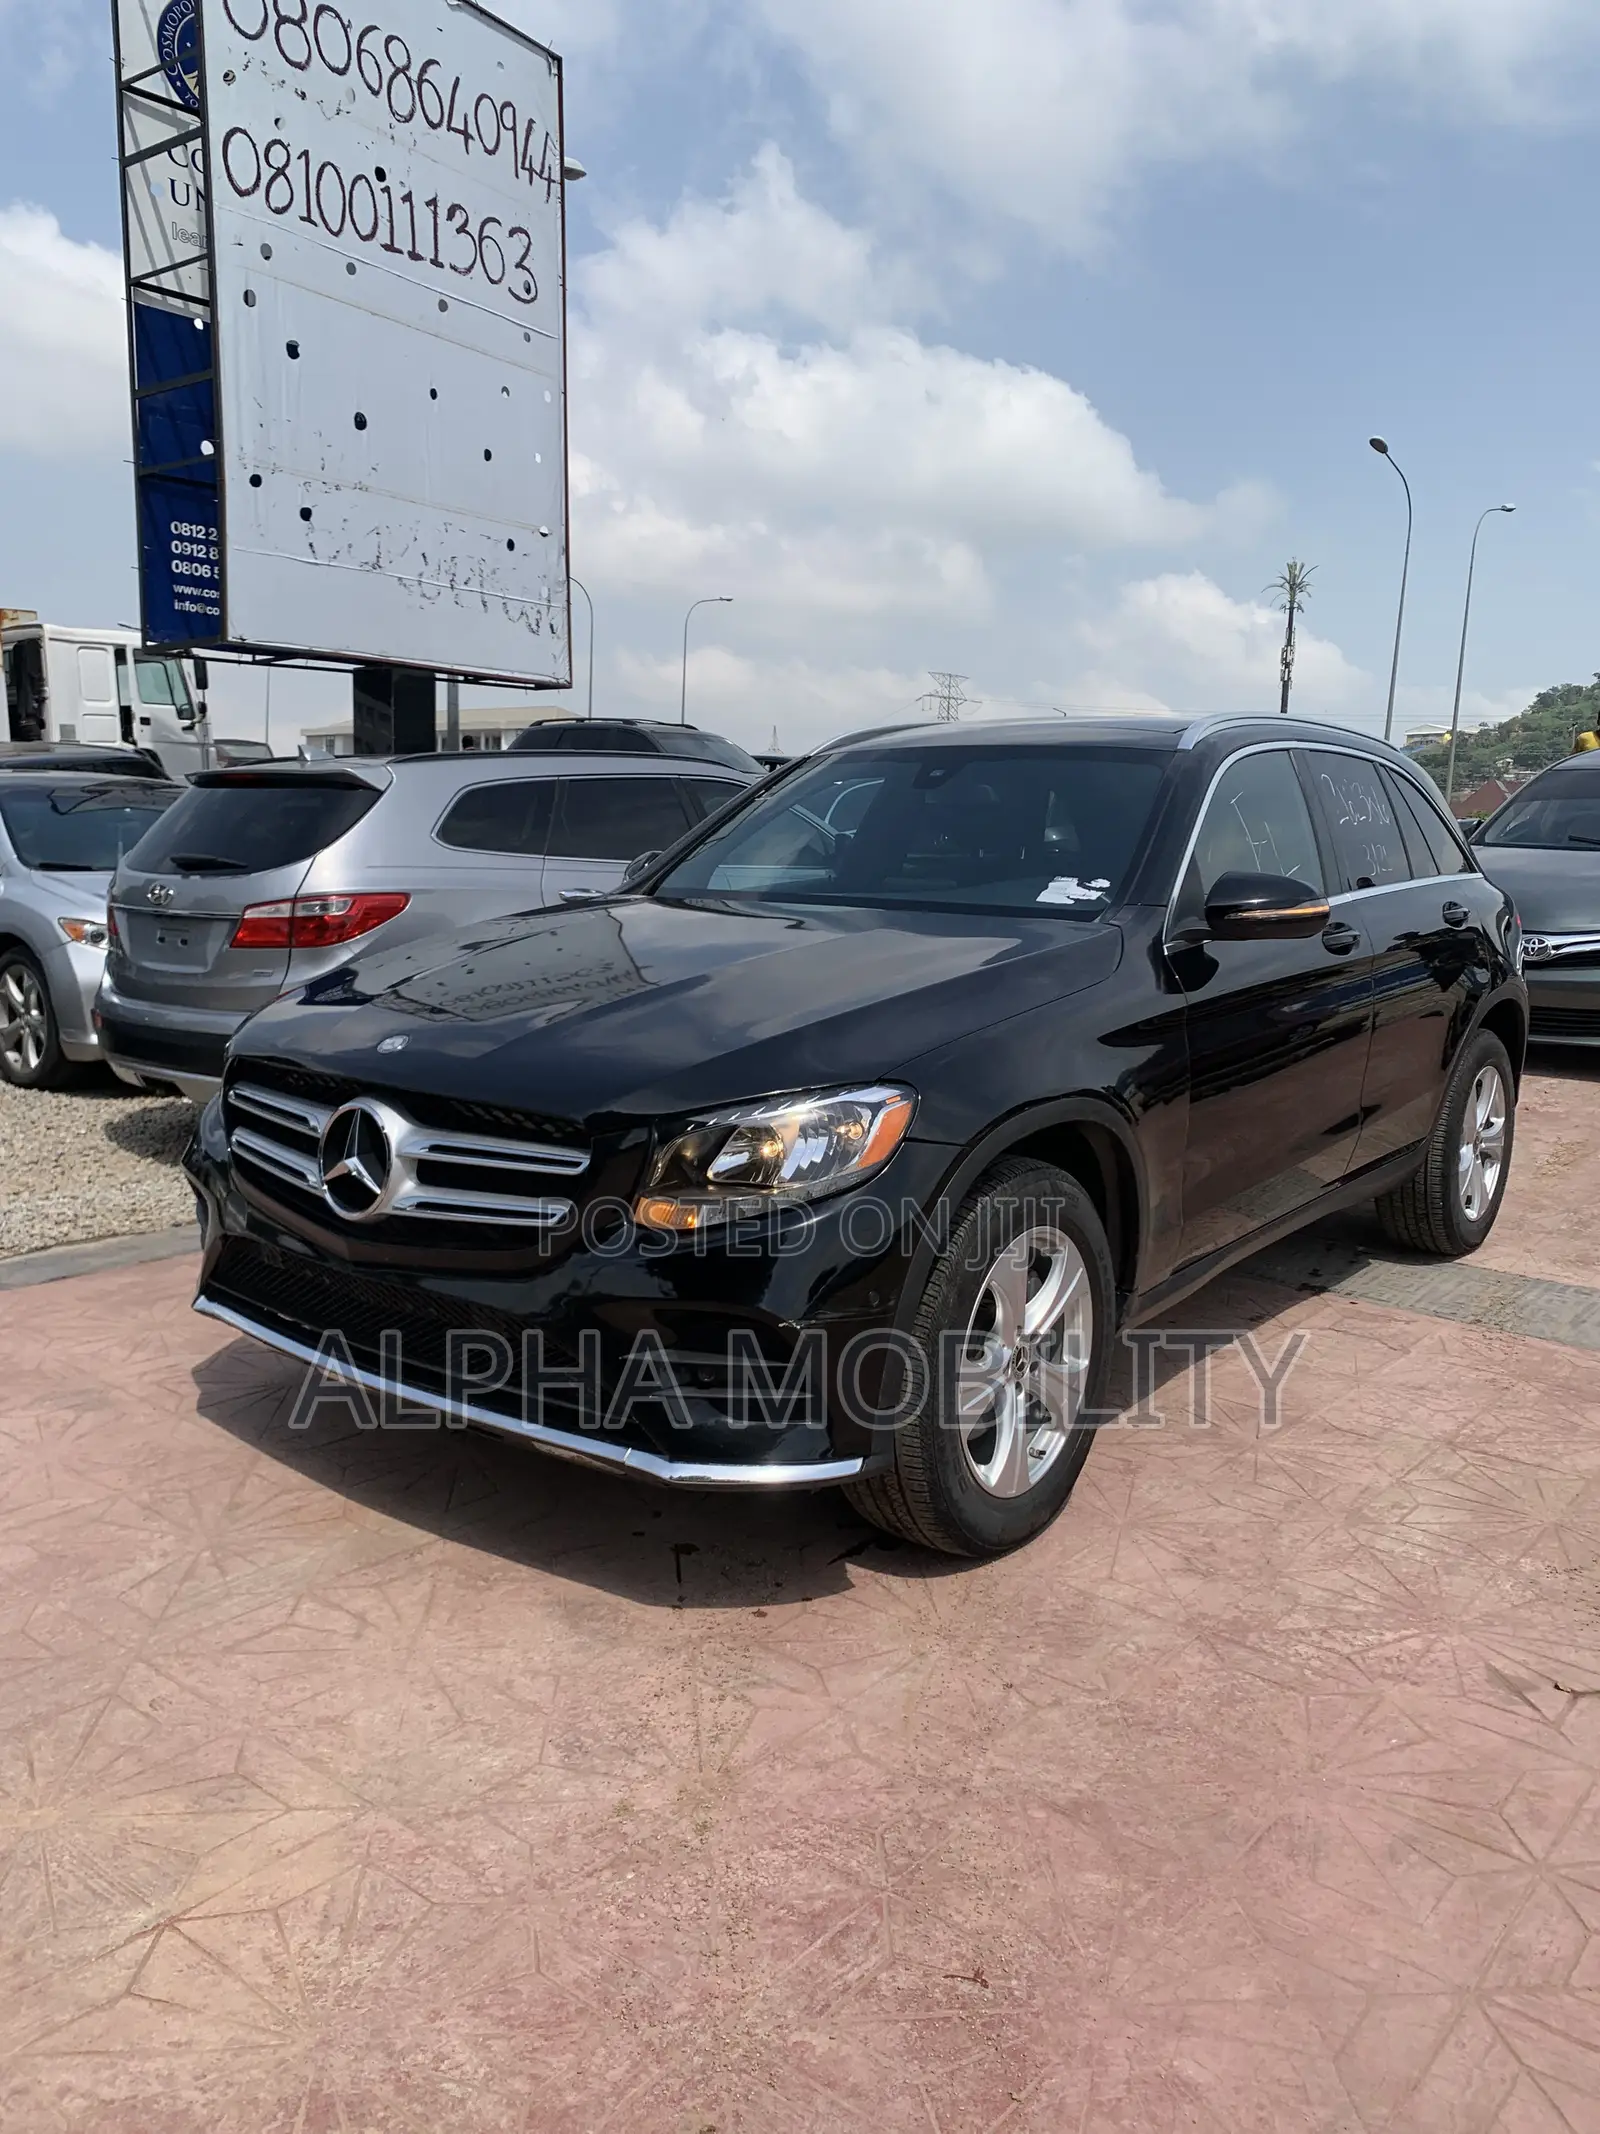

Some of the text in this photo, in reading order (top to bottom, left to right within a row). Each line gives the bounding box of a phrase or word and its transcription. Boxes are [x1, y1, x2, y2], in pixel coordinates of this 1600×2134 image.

[161, 0, 195, 76] COSMOPO
[222, 126, 538, 304] 08100111363
[170, 521, 218, 541] 0812 2
[171, 540, 219, 560] 0912 8
[171, 560, 211, 578] 0806
